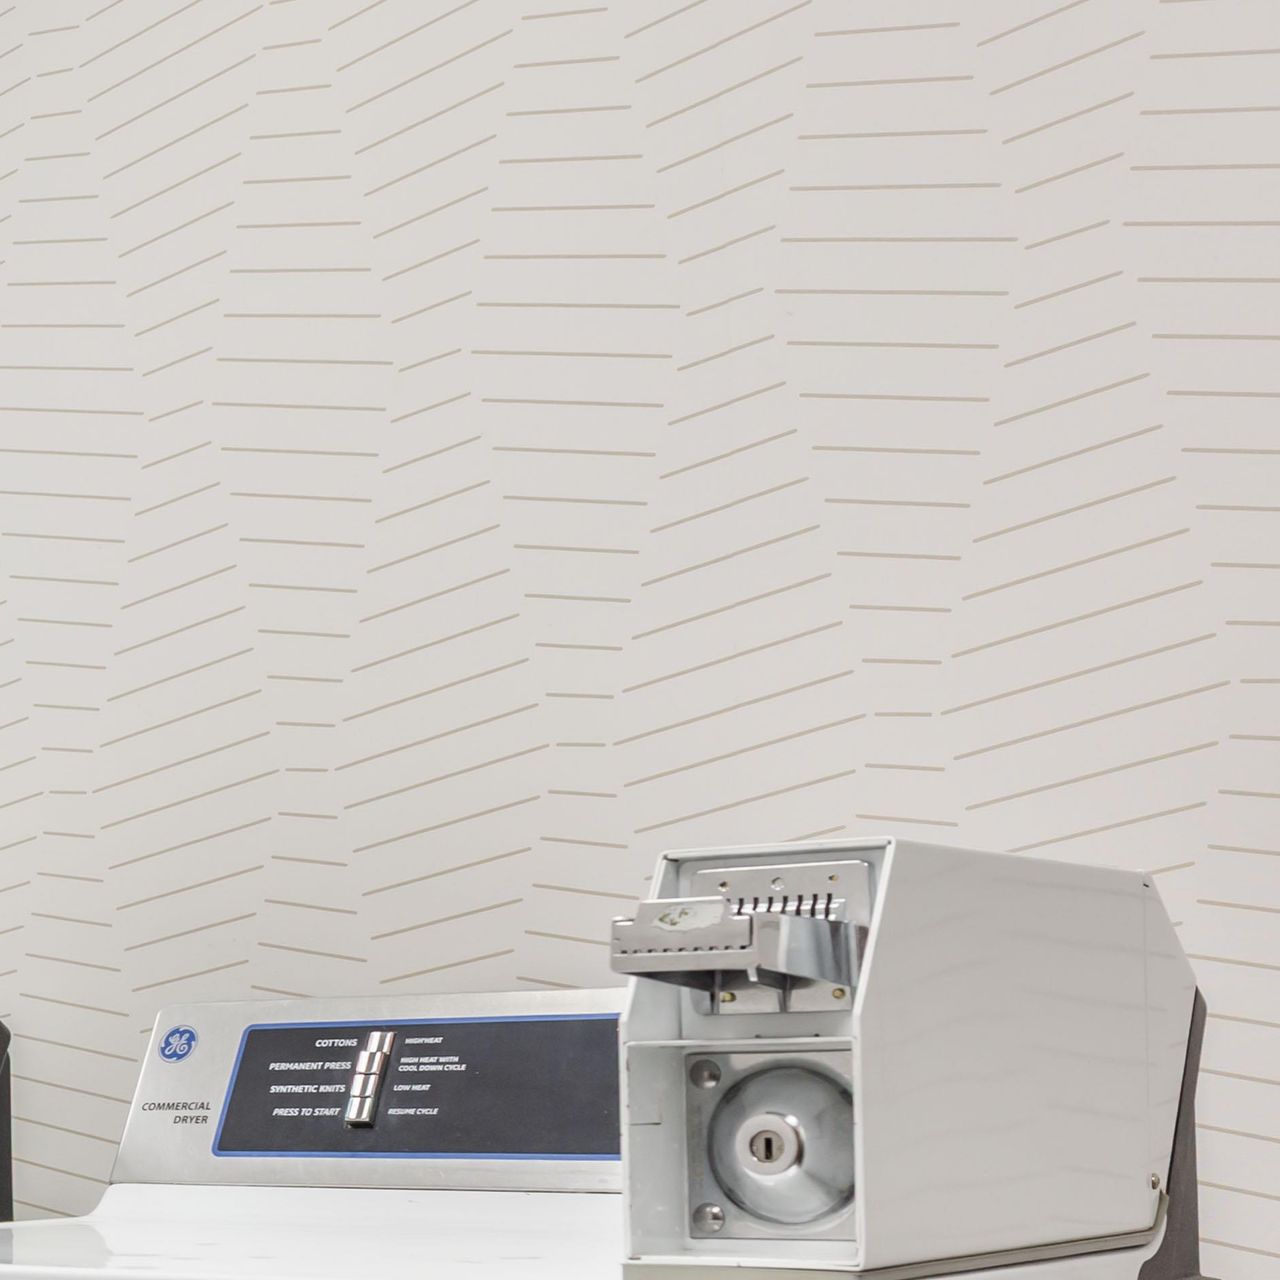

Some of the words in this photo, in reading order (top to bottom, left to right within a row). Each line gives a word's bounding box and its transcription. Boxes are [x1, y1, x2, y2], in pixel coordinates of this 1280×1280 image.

[162, 1029, 194, 1060] GE
[315, 1039, 358, 1047] COTTONS
[268, 1062, 323, 1071] PERMANENT
[323, 1061, 352, 1070] PRESS
[269, 1085, 318, 1093] SYNTHETIC
[318, 1084, 346, 1092] KNITS
[141, 1102, 212, 1111] COMMERCIAL
[272, 1108, 300, 1116] PRESS
[300, 1108, 313, 1116] TO
[313, 1108, 341, 1116] START
[173, 1115, 209, 1124] DRYER
